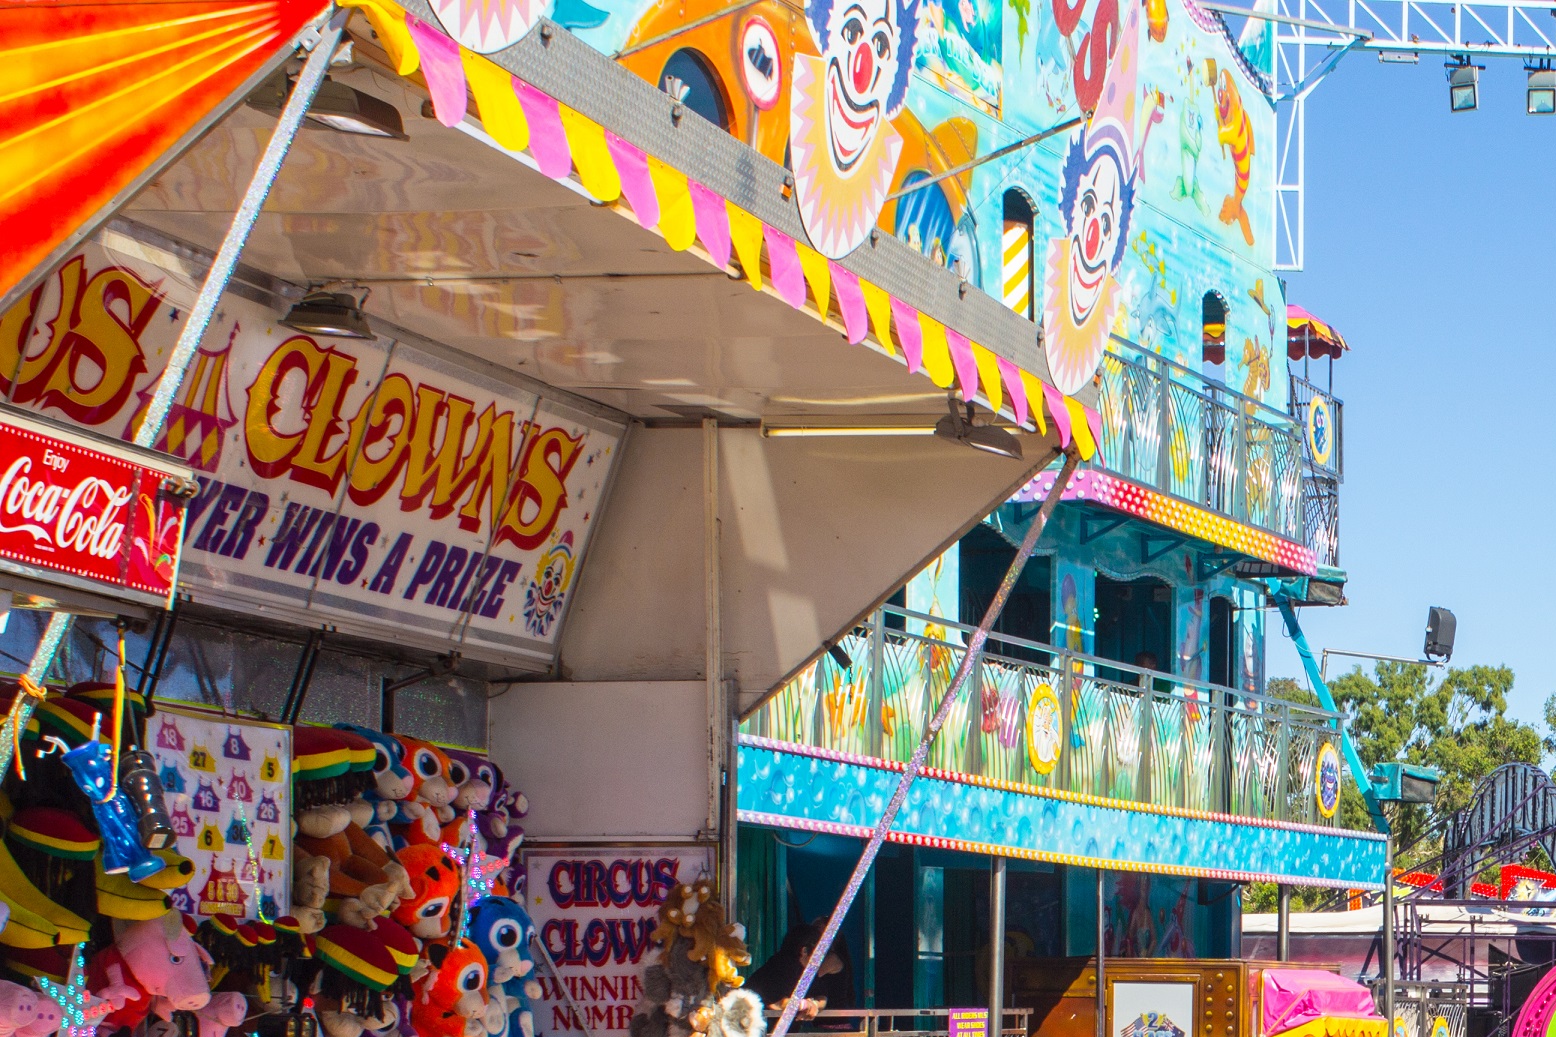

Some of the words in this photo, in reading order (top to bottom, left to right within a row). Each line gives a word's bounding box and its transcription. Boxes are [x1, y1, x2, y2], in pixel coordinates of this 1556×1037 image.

[244, 335, 586, 551] CLOWNS
[42, 448, 71, 474] Enjoy
[0, 456, 133, 561] Coca-Cola
[264, 501, 381, 586] WINS
[369, 531, 414, 595] A
[404, 540, 523, 620] PRIZE
[161, 727, 178, 746] 18
[231, 738, 240, 755] 8
[266, 762, 275, 778] 5
[232, 778, 247, 797] 10
[260, 803, 275, 820] 26
[172, 816, 189, 834] 25
[204, 829, 213, 847] 6
[268, 839, 276, 856] 7
[546, 858, 681, 910] CIRCUS
[171, 892, 188, 911] 22
[1147, 1011, 1159, 1028] 2
